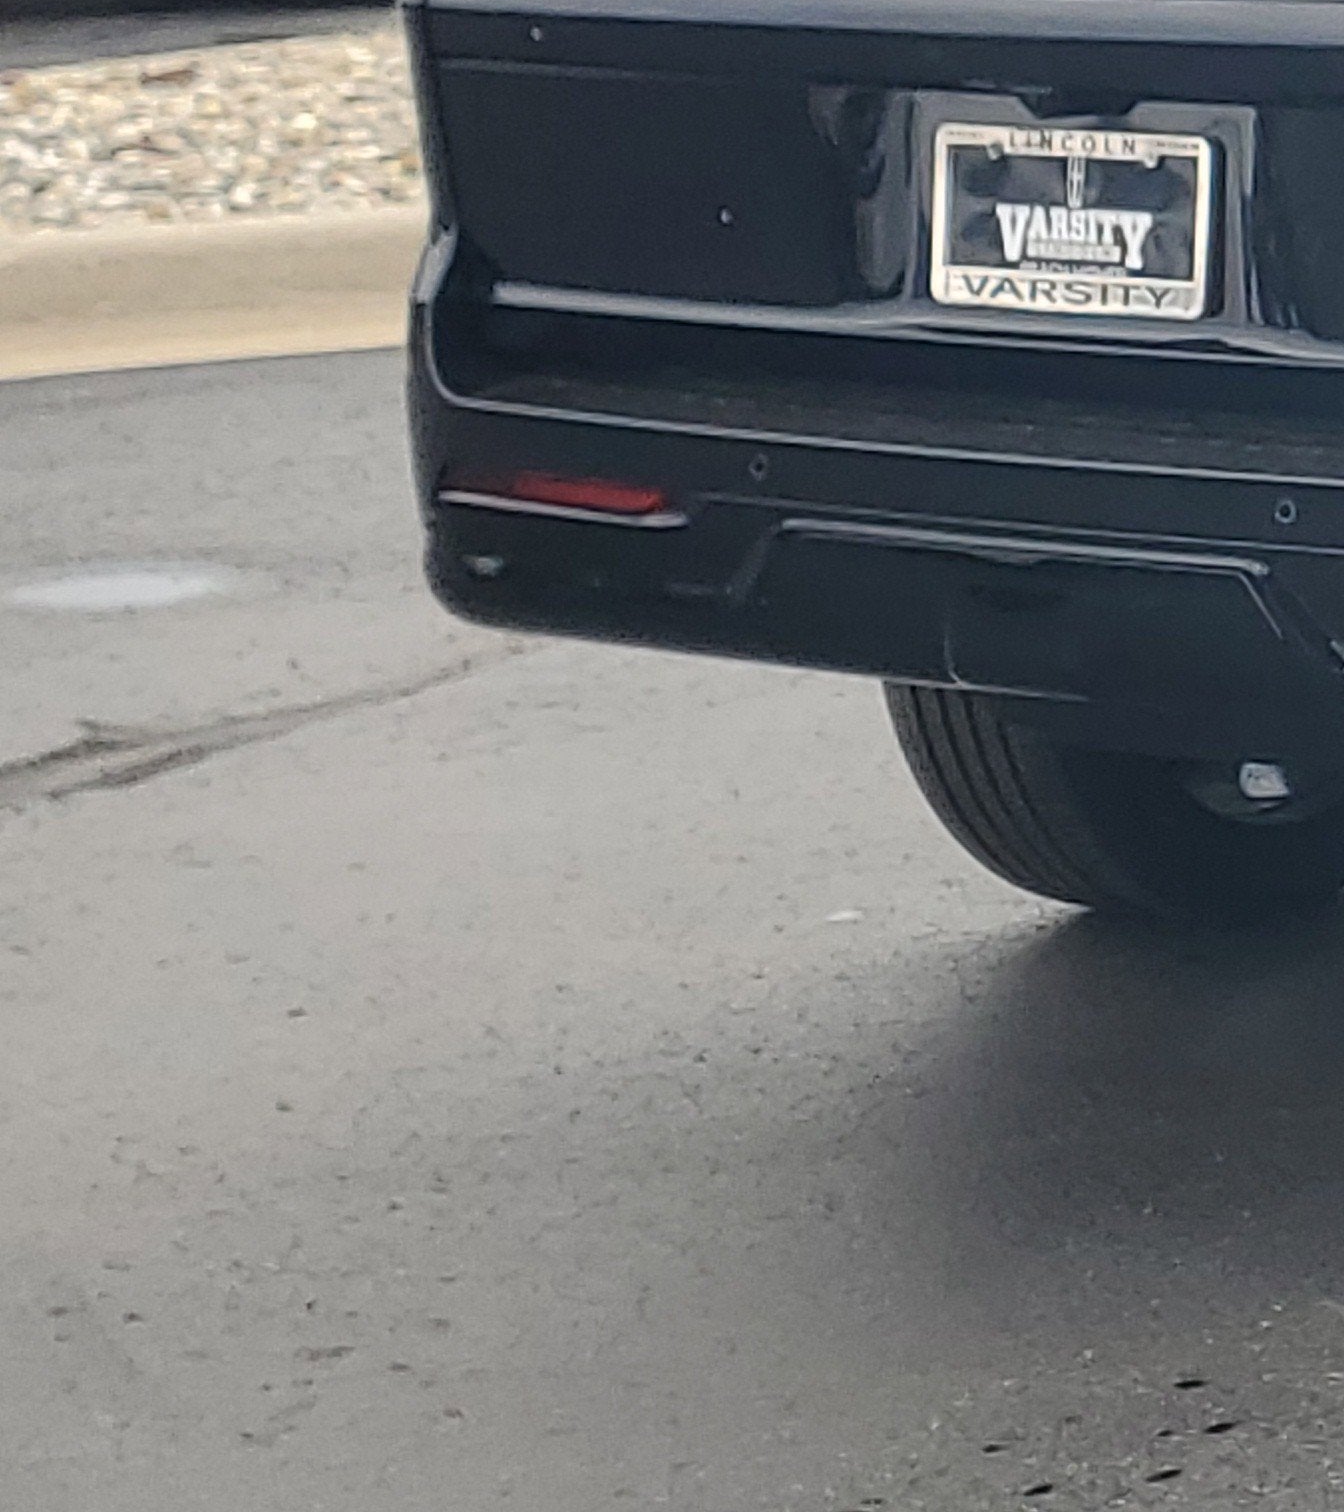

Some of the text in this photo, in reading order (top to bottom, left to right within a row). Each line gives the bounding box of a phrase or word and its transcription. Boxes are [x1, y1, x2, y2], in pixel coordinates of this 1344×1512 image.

[1007, 128, 1137, 155] LINCOLN
[995, 202, 1153, 270] VARSITY
[961, 274, 1171, 309] VARSITY
